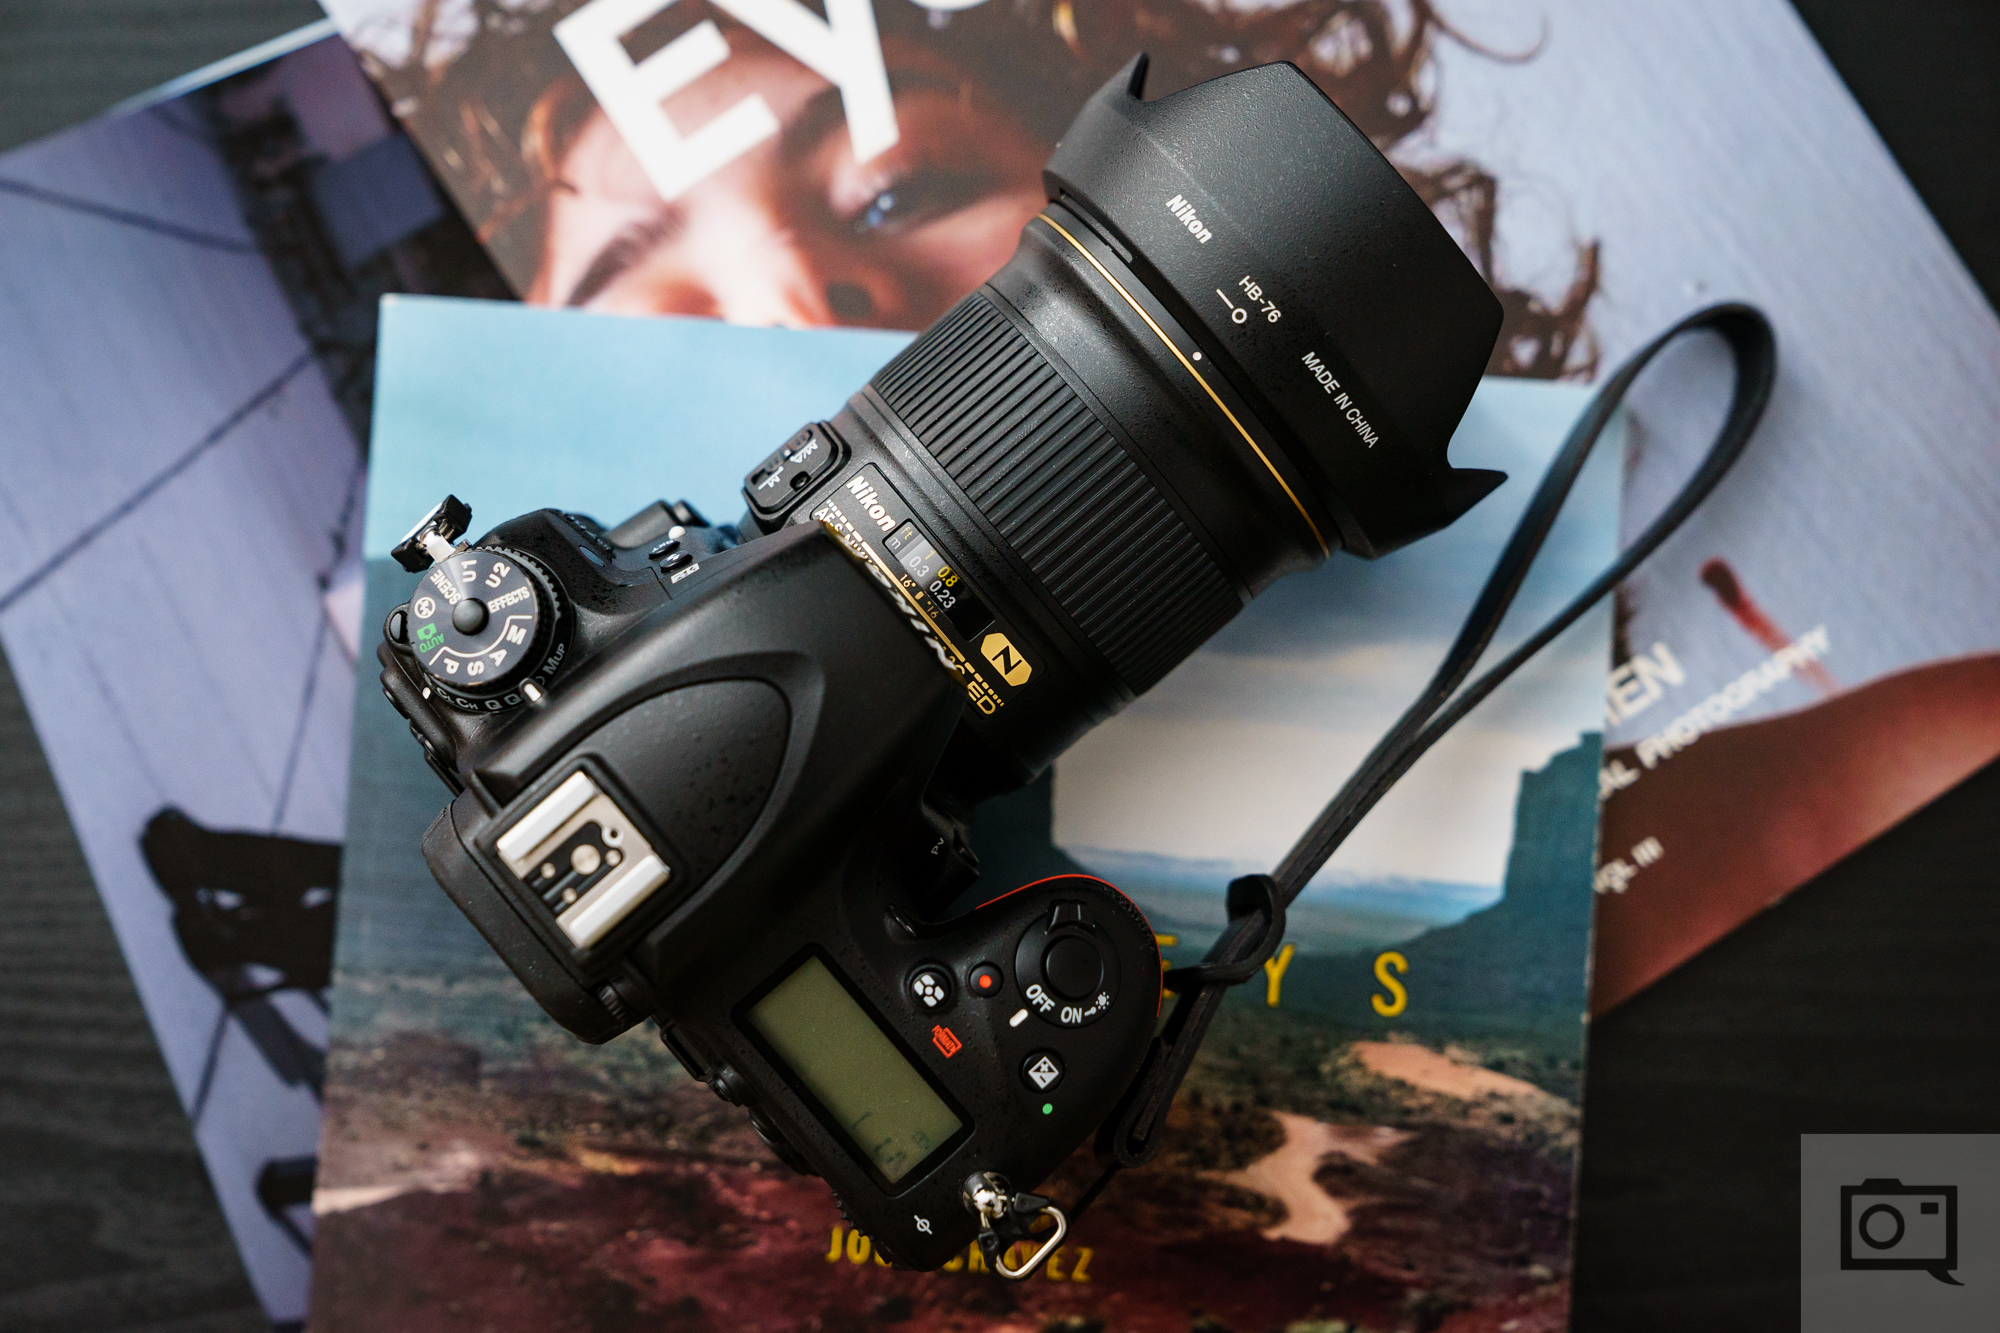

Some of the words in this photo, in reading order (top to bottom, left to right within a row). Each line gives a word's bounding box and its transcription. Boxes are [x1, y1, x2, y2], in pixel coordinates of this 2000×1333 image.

[552, 0, 990, 202] EY
[1165, 194, 1213, 244] Nikon
[1238, 275, 1282, 324] HB-76
[1301, 351, 1340, 394] MADE
[1333, 392, 1353, 411] IN
[1345, 408, 1379, 449] CHINA
[846, 475, 896, 532] Nikon
[460, 559, 478, 583] U1
[900, 526, 914, 541] ft
[925, 550, 937, 561] 1
[938, 565, 958, 587] 0.8
[430, 569, 461, 606] SCENE
[485, 562, 511, 588] U2
[889, 536, 902, 549] m
[908, 556, 930, 578] 0.3
[929, 580, 957, 609] 0.23
[487, 586, 531, 614] EFFECTS
[418, 632, 445, 653] AUTO
[506, 624, 527, 645] M
[443, 657, 460, 675] P
[467, 660, 485, 676] S
[489, 648, 508, 667] A
[991, 645, 1022, 676] N
[1606, 642, 1685, 728] EN
[1635, 623, 1829, 770] PHOTOGRAPHY
[1025, 984, 1056, 1013] OFF
[1060, 1006, 1082, 1024] ON
[931, 1024, 957, 1053] FORMAT
[825, 1225, 894, 1268] JO
